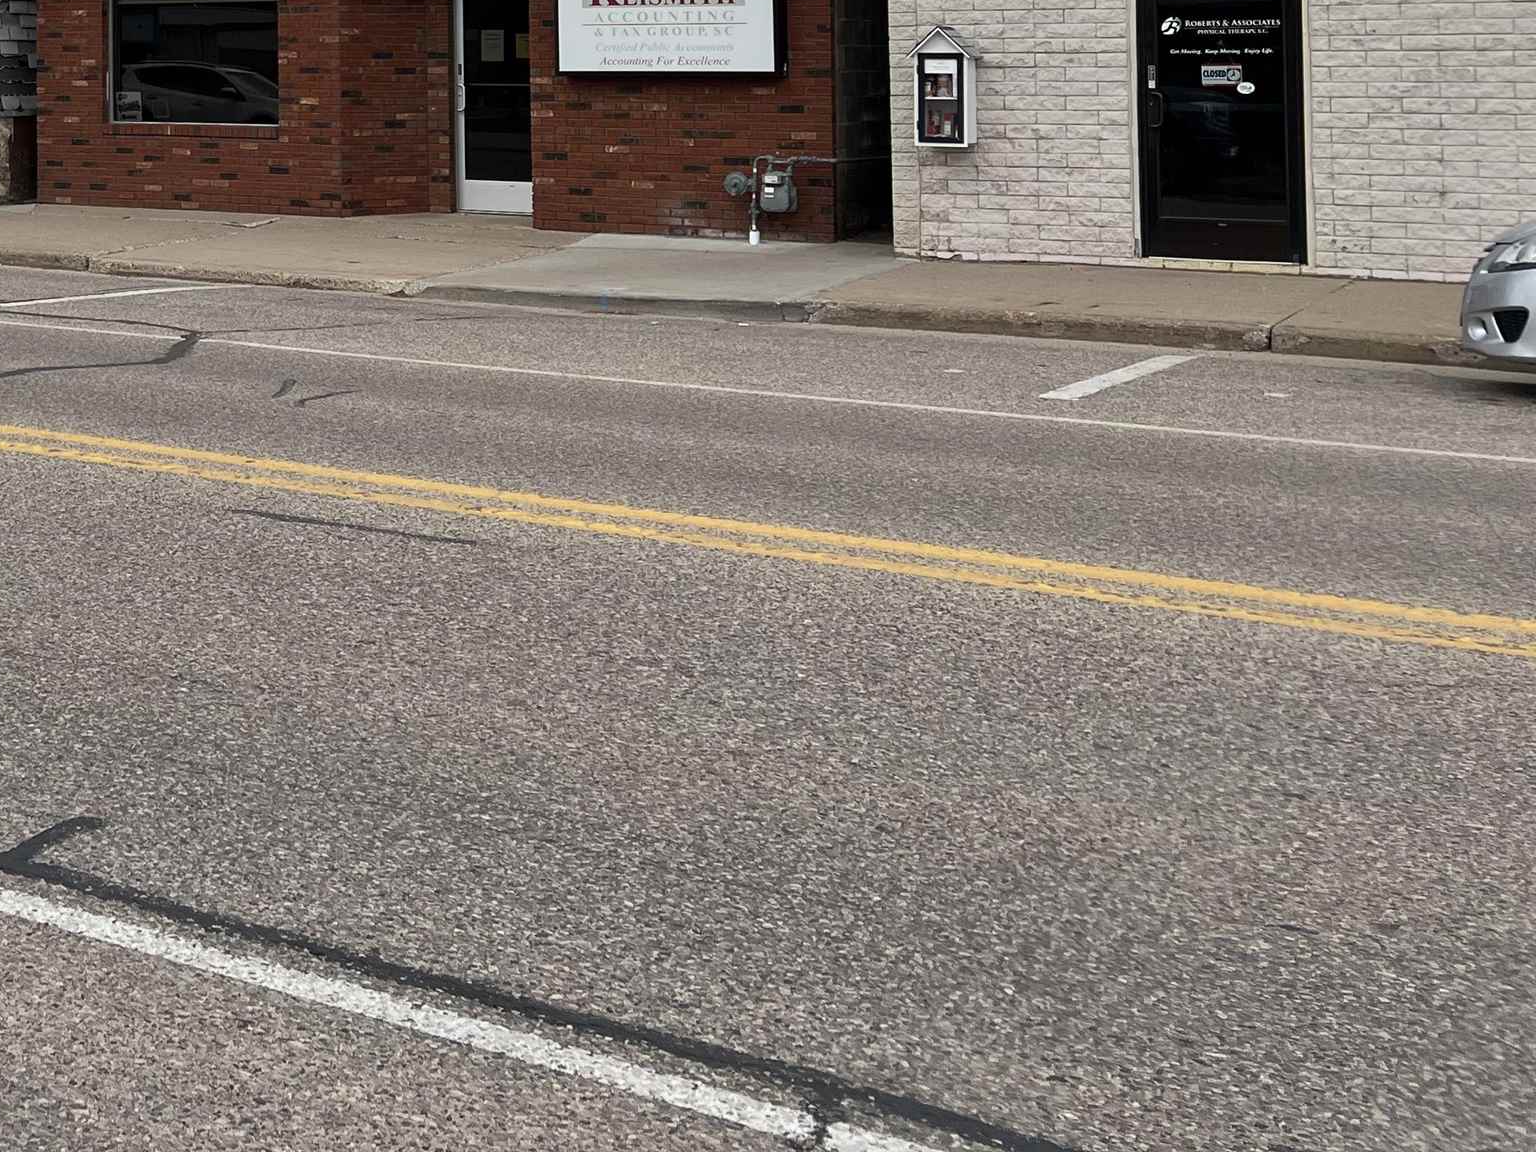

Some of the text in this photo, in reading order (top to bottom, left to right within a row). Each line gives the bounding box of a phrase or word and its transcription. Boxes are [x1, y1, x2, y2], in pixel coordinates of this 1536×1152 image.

[594, 10, 735, 23] ACCOUNTING
[594, 27, 604, 36] &
[611, 27, 641, 36] TAX
[600, 56, 731, 67] Accounting For Excellence
[1203, 69, 1227, 78] CLOSED
